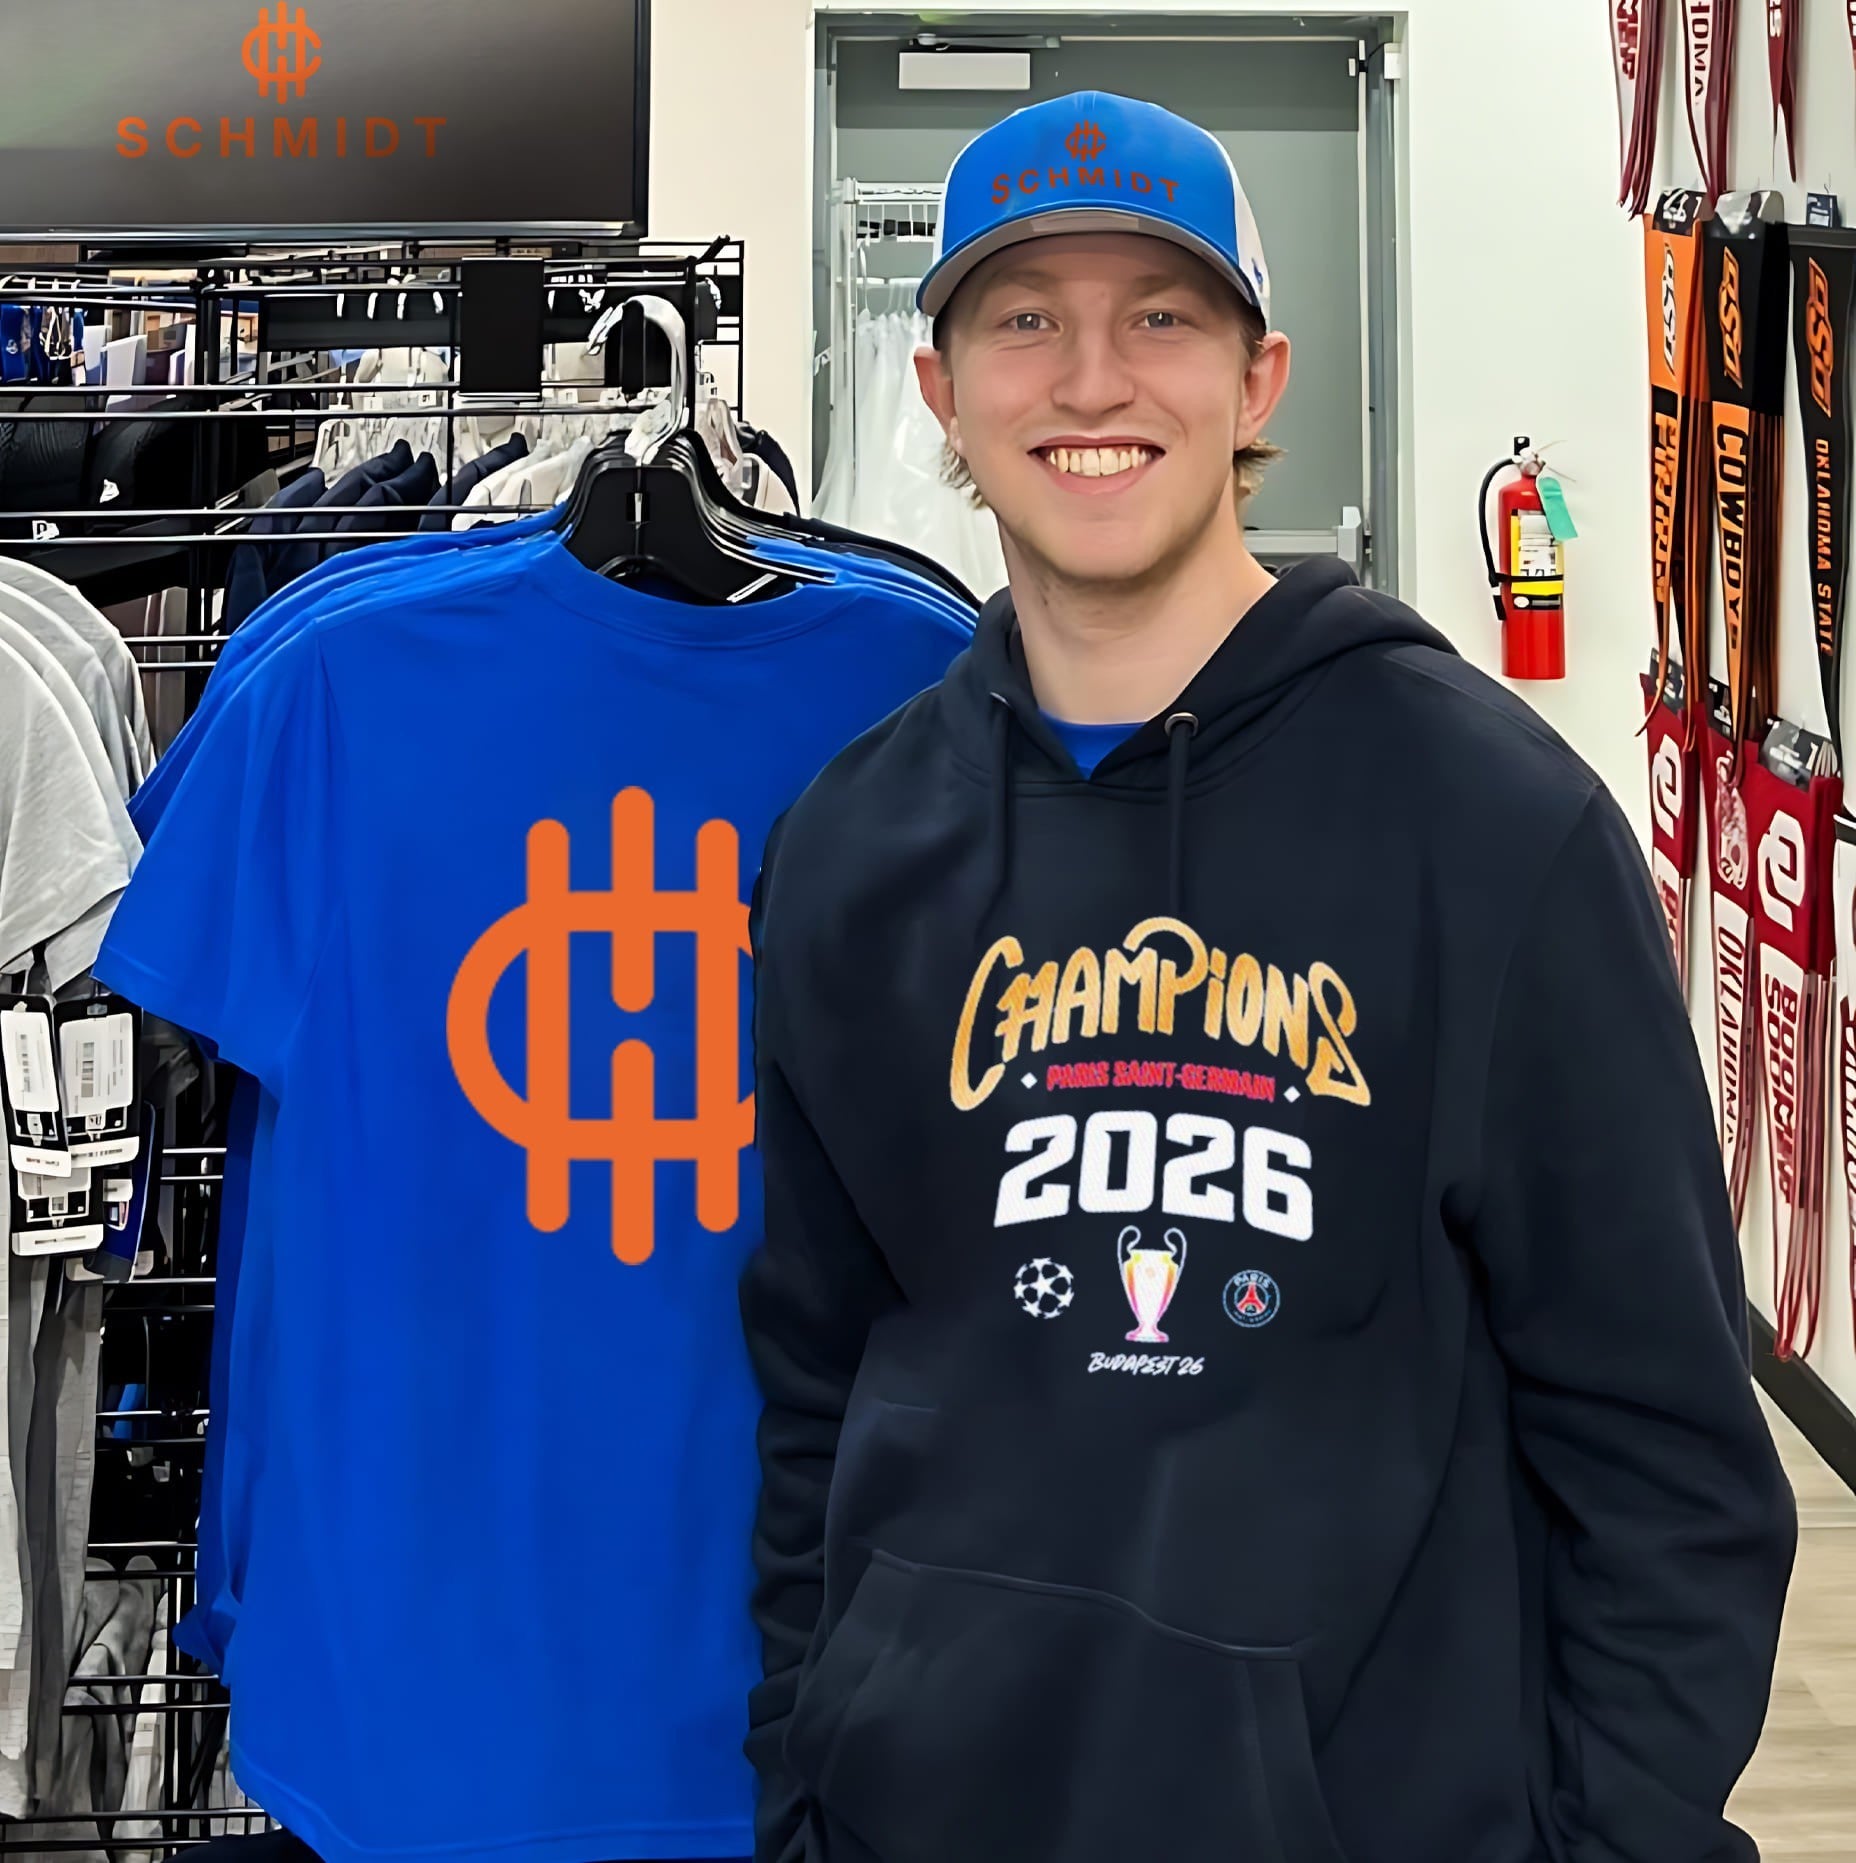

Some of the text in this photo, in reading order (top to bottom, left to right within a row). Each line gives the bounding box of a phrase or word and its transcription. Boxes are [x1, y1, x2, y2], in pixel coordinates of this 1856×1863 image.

[116, 106, 447, 159] SCHMIDT
[991, 167, 1179, 204] SCHMIDT
[1815, 438, 1833, 571] OKLAHOMA
[1718, 925, 1746, 1145] OKLAHOMA
[1047, 1060, 1276, 1103] PARIS SAINT-GERMAIN
[993, 1110, 1314, 1242] 2026
[1233, 1272, 1271, 1289] PARIS
[1088, 1352, 1205, 1376] BUDAPEST 26
